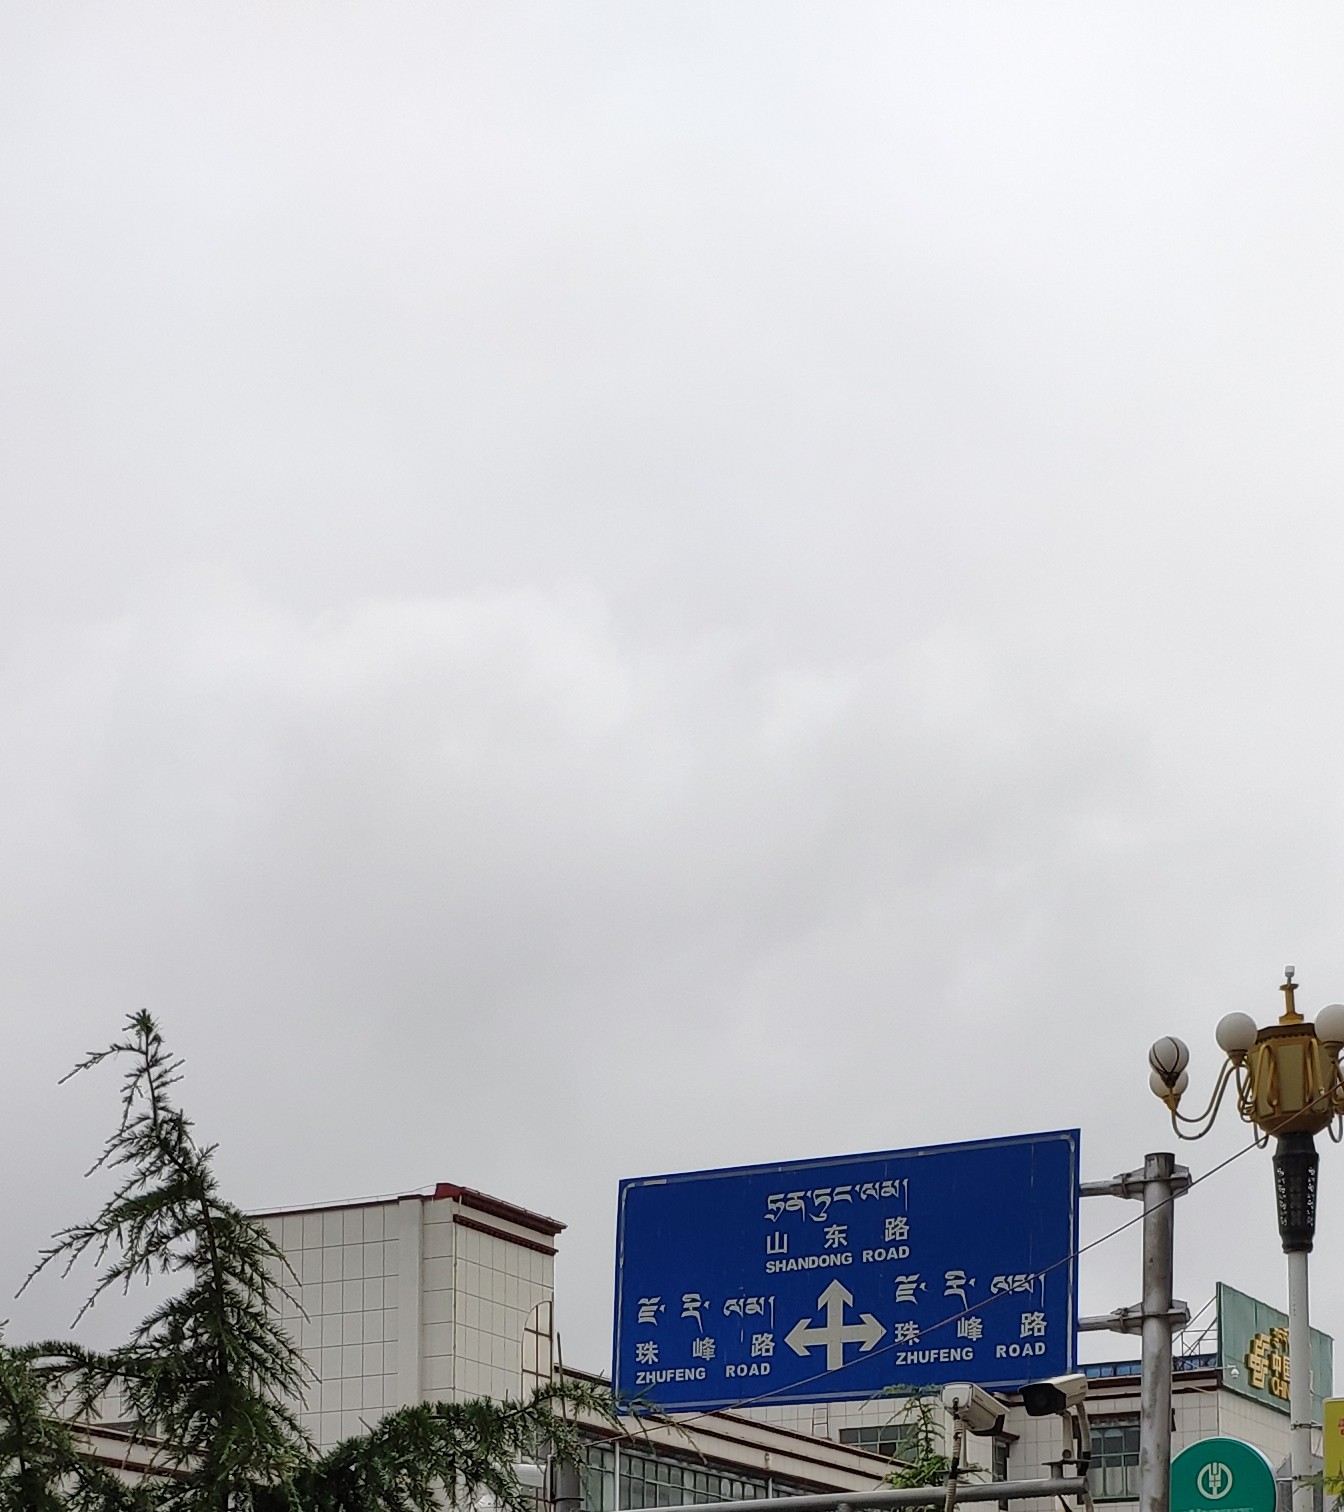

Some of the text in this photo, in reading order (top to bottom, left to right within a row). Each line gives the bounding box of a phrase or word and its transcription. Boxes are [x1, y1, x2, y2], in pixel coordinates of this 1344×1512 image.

[766, 1216, 910, 1254] 山东路
[765, 1246, 910, 1273] SHANDONG ROAD
[894, 1311, 1047, 1346] 珠峰路
[636, 1333, 775, 1365] 珠峰路
[895, 1342, 1046, 1365] ZHUFENG ROAD
[636, 1363, 771, 1384] ZHUFENG ROAD
